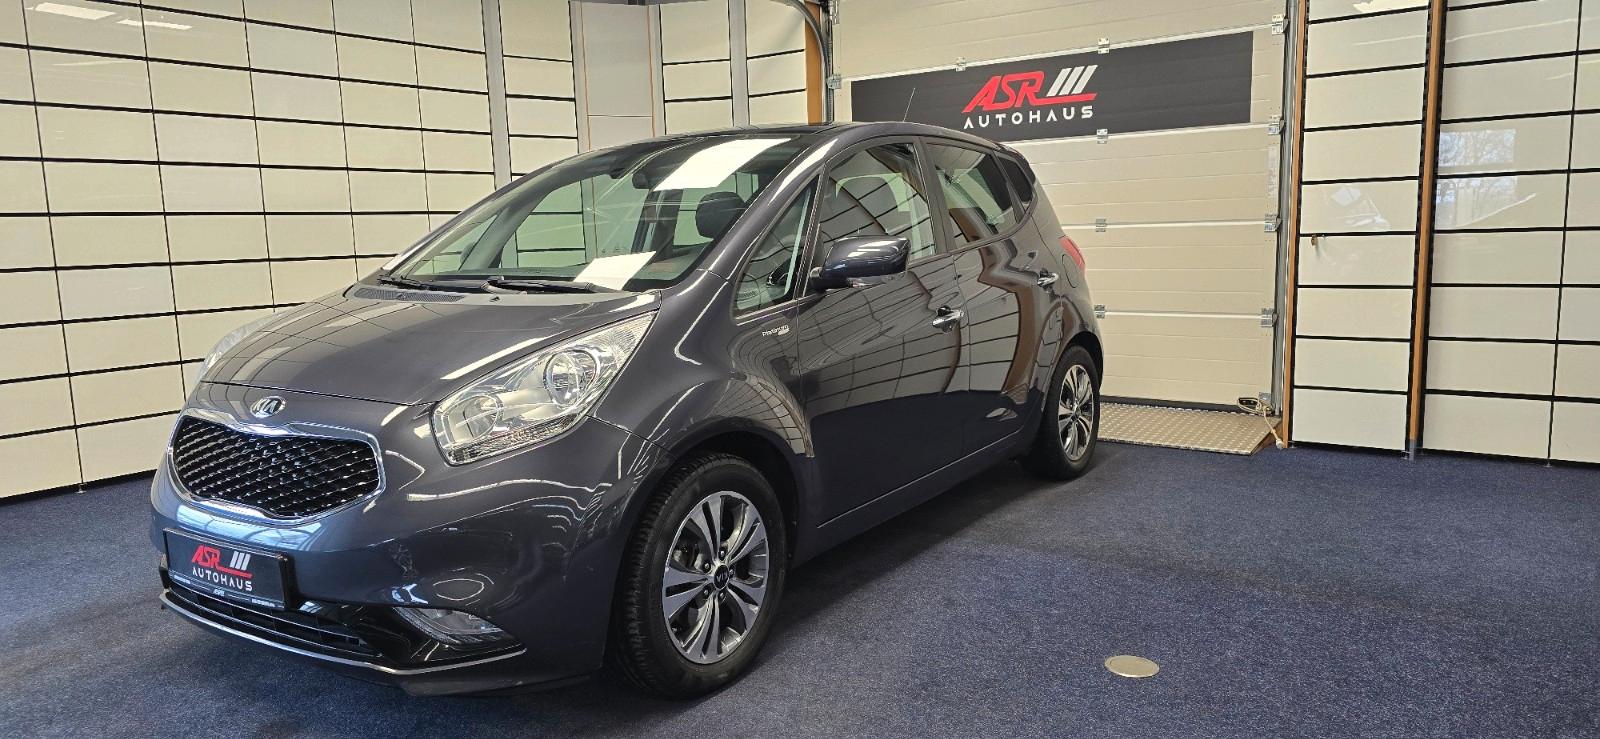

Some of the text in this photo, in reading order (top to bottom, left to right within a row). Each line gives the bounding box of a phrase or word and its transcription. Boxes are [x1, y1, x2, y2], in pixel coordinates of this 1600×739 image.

[962, 71, 1097, 113] ASR
[963, 105, 1093, 129] AUTOHAUS
[192, 567, 253, 592] AUTOHAUS
